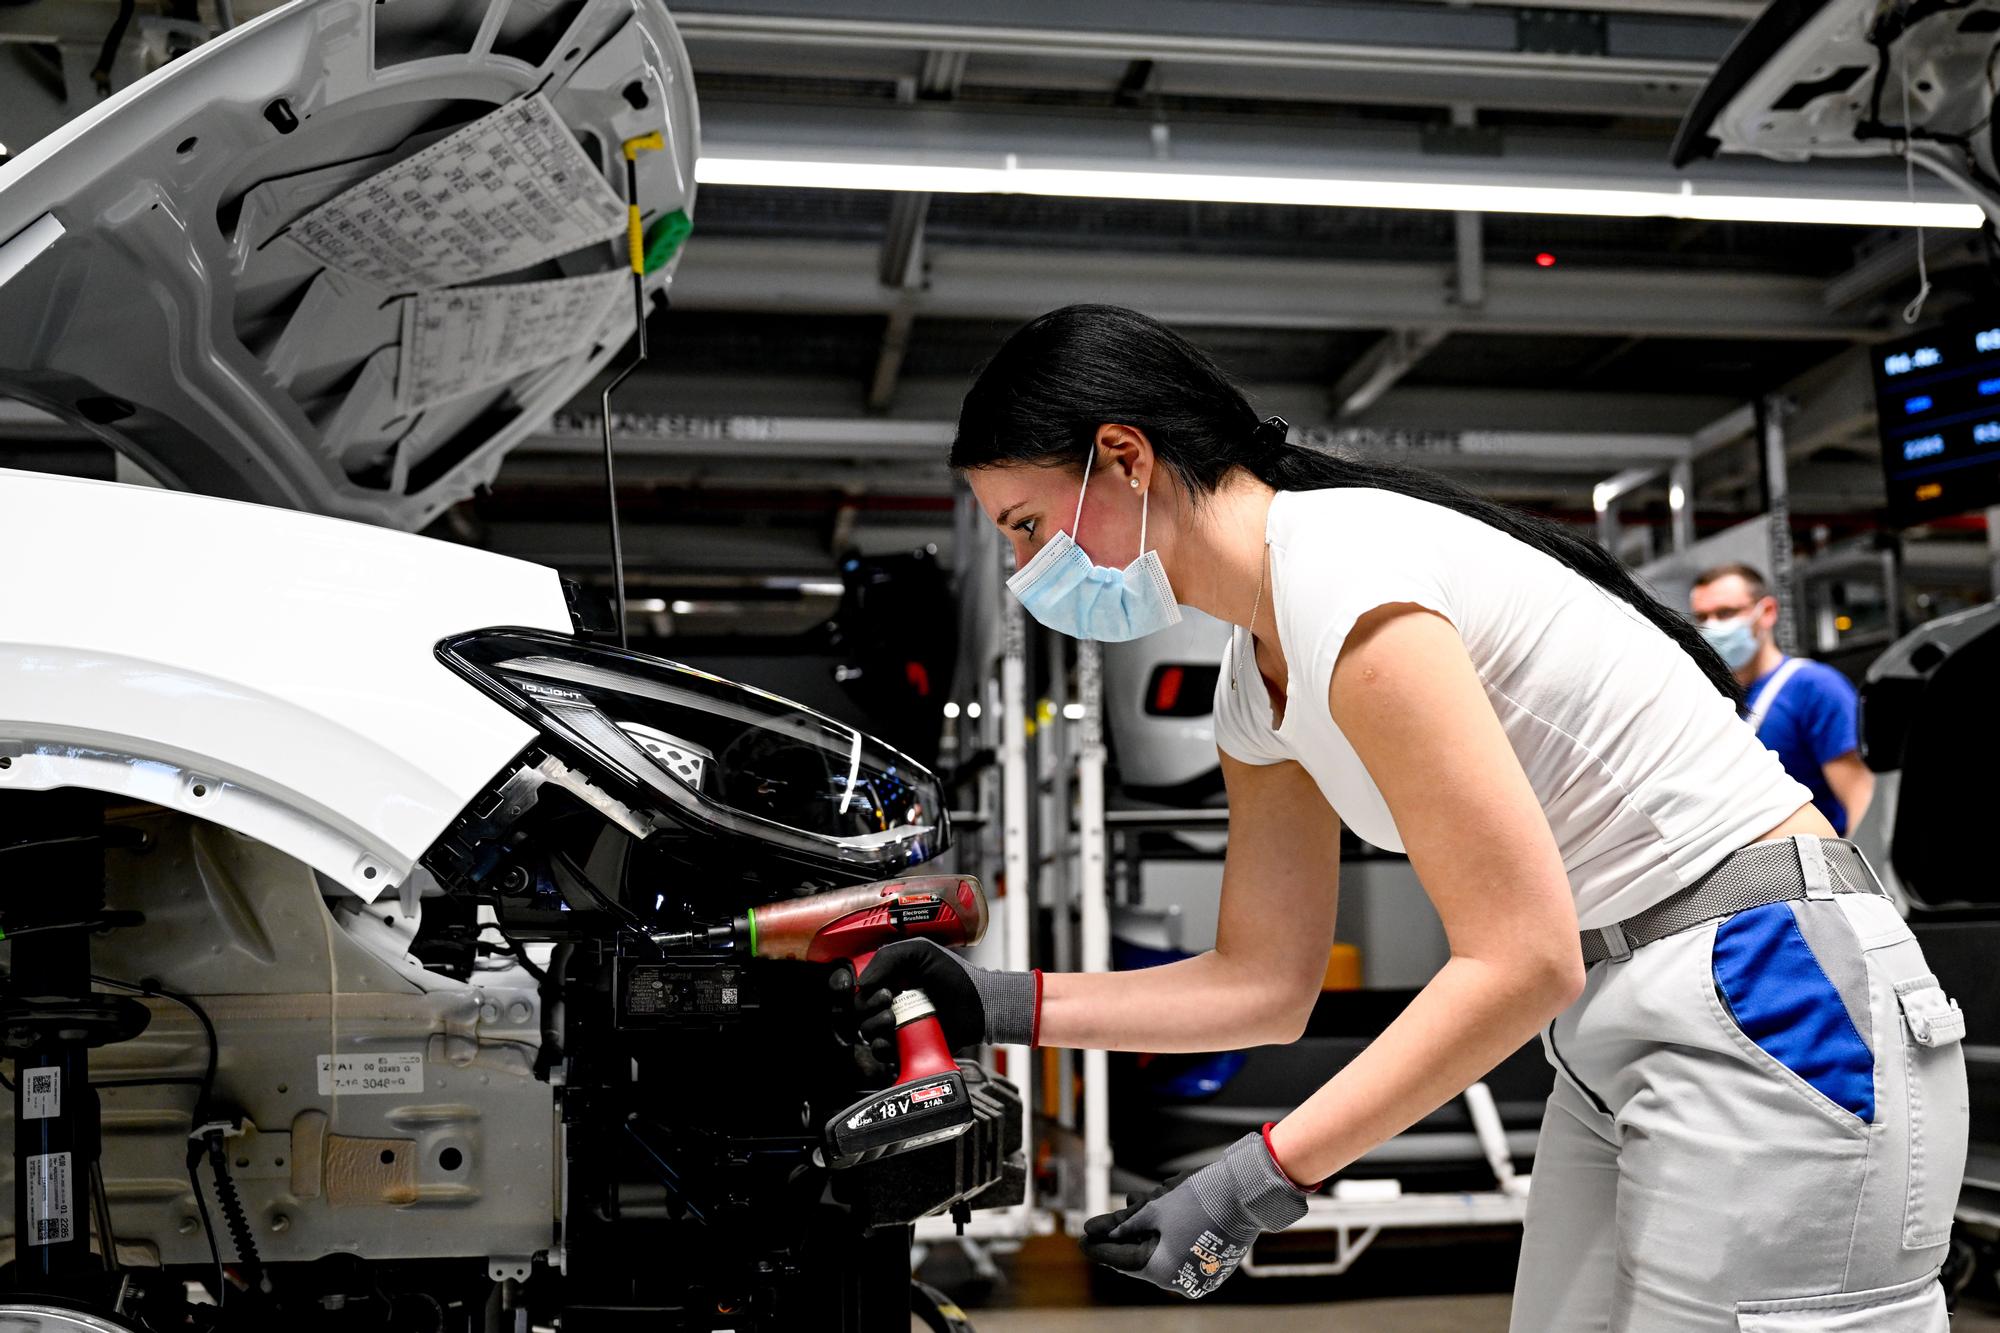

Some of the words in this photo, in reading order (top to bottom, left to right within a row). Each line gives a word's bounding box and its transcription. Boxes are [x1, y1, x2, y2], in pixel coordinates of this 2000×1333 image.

[521, 683, 582, 699] IQ.LIGHT
[902, 909, 929, 917] Electronic
[879, 1103, 897, 1119] 18
[898, 1099, 910, 1114] V
[60, 1218, 69, 1238] 2285
